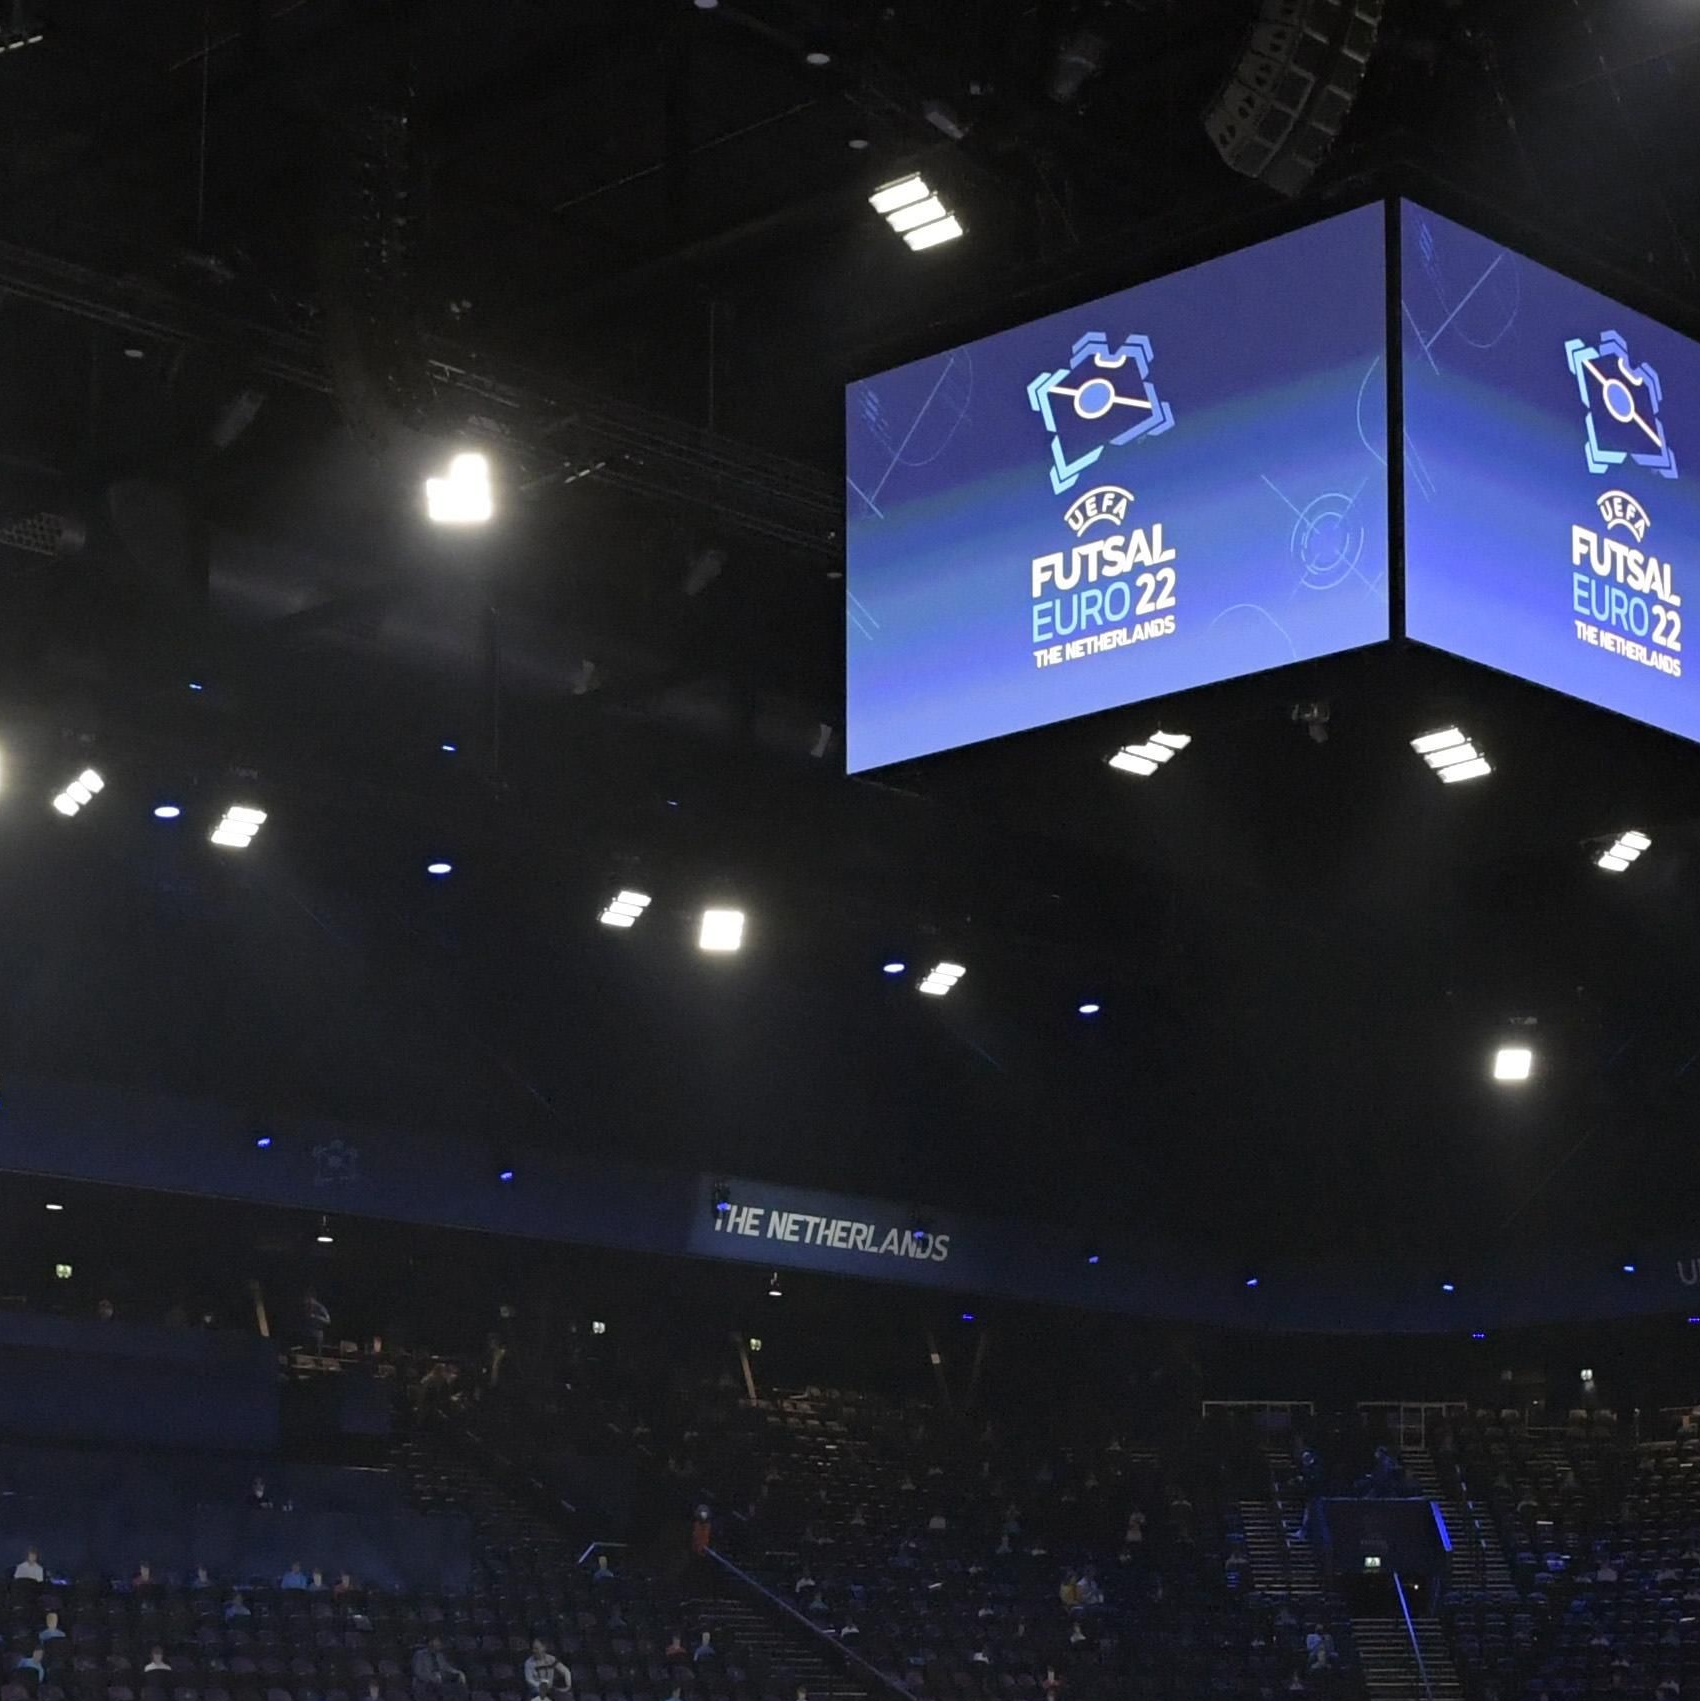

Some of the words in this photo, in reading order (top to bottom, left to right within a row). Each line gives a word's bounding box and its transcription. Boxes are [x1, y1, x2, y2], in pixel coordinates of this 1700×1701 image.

[1068, 492, 1127, 531] UEFA
[1600, 497, 1645, 538] UEFA
[1032, 523, 1176, 598] FUTSAL
[1572, 524, 1681, 607] FUTSAL
[1033, 581, 1131, 643] EURO
[1135, 567, 1176, 615] 22
[1573, 572, 1648, 637] EURO
[1651, 604, 1681, 652] 22
[1033, 645, 1063, 668] THE
[1065, 615, 1176, 661] NETHERLANDS
[1574, 619, 1598, 646] THE
[1599, 629, 1681, 677] NETHERLANDS
[767, 1210, 949, 1261] NETHERLANDS
